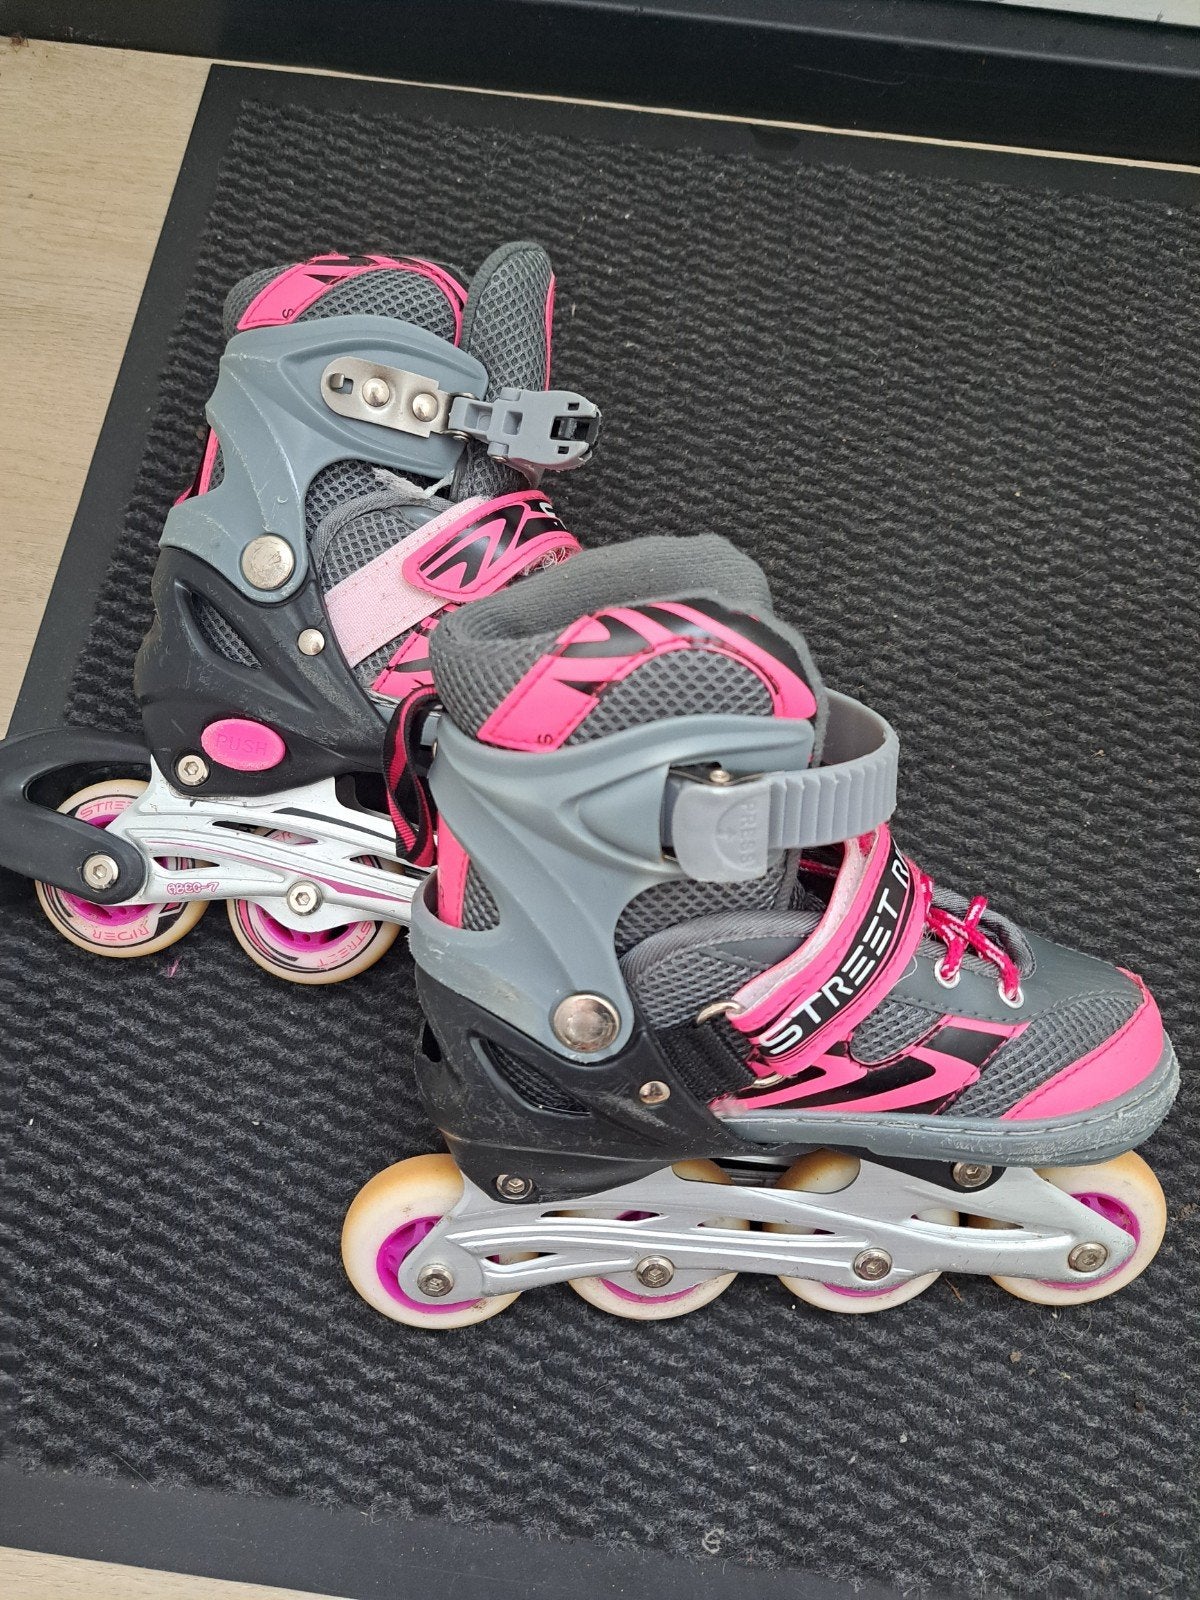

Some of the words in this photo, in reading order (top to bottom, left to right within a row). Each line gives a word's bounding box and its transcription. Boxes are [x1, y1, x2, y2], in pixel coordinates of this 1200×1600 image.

[216, 733, 267, 756] PUSH
[92, 925, 150, 941] RIDER
[317, 920, 372, 967] STREET
[758, 888, 898, 1055] STREET
